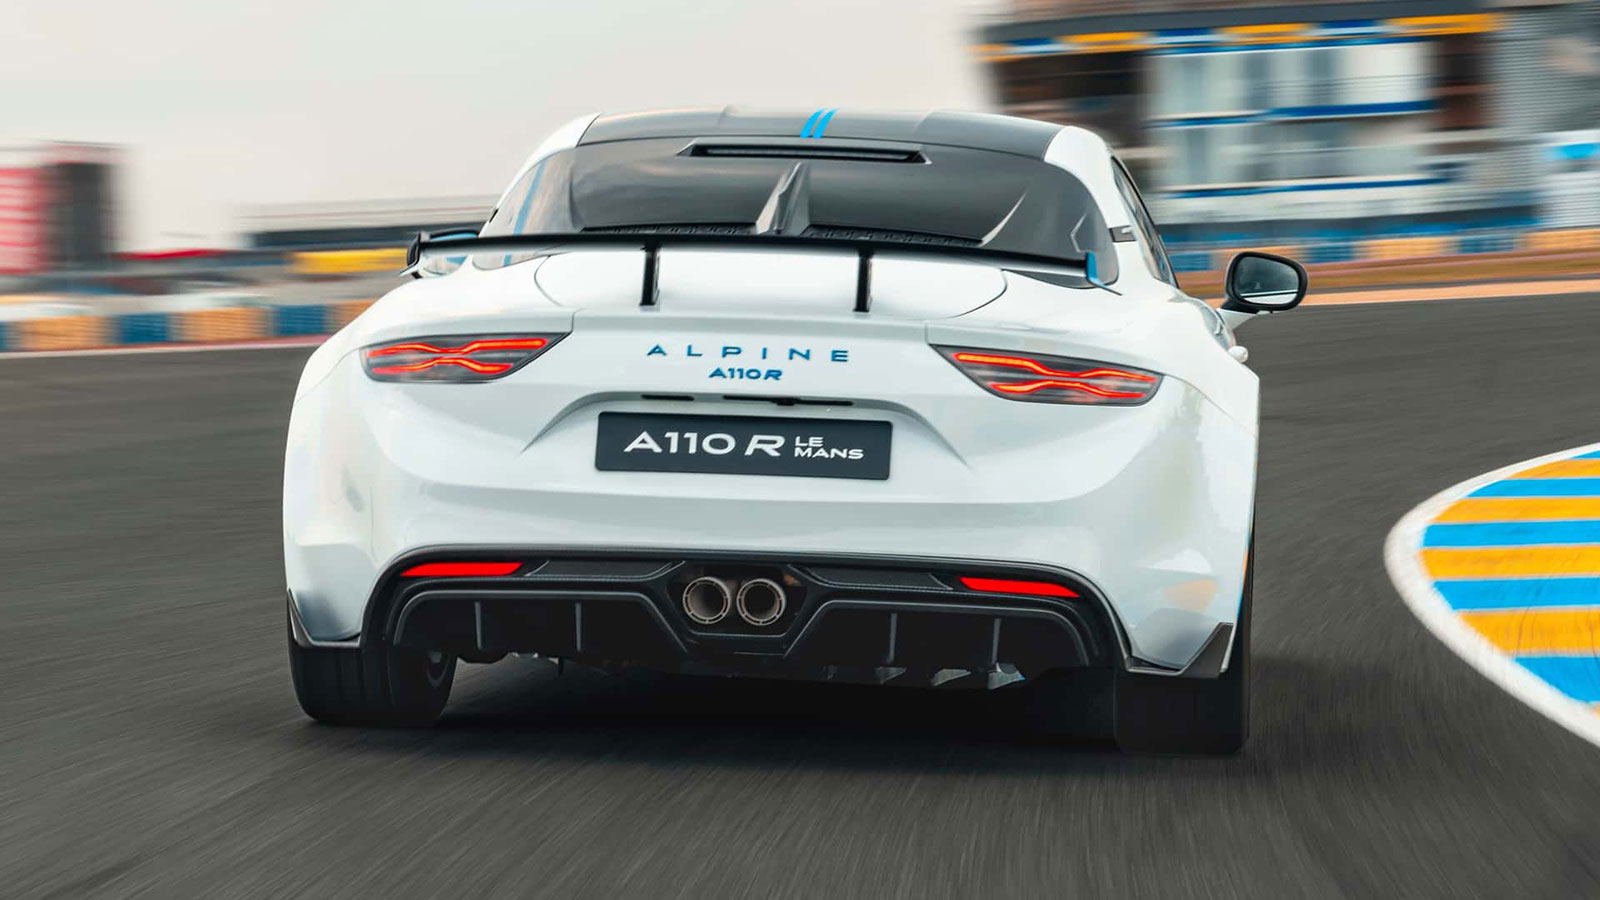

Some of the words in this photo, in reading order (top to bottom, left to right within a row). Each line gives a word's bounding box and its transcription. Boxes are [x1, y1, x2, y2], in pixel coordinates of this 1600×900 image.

[646, 344, 850, 363] ALPINE
[623, 430, 737, 456] A110
[744, 434, 786, 457] R
[794, 435, 824, 448] LE
[794, 447, 865, 461] MANS
